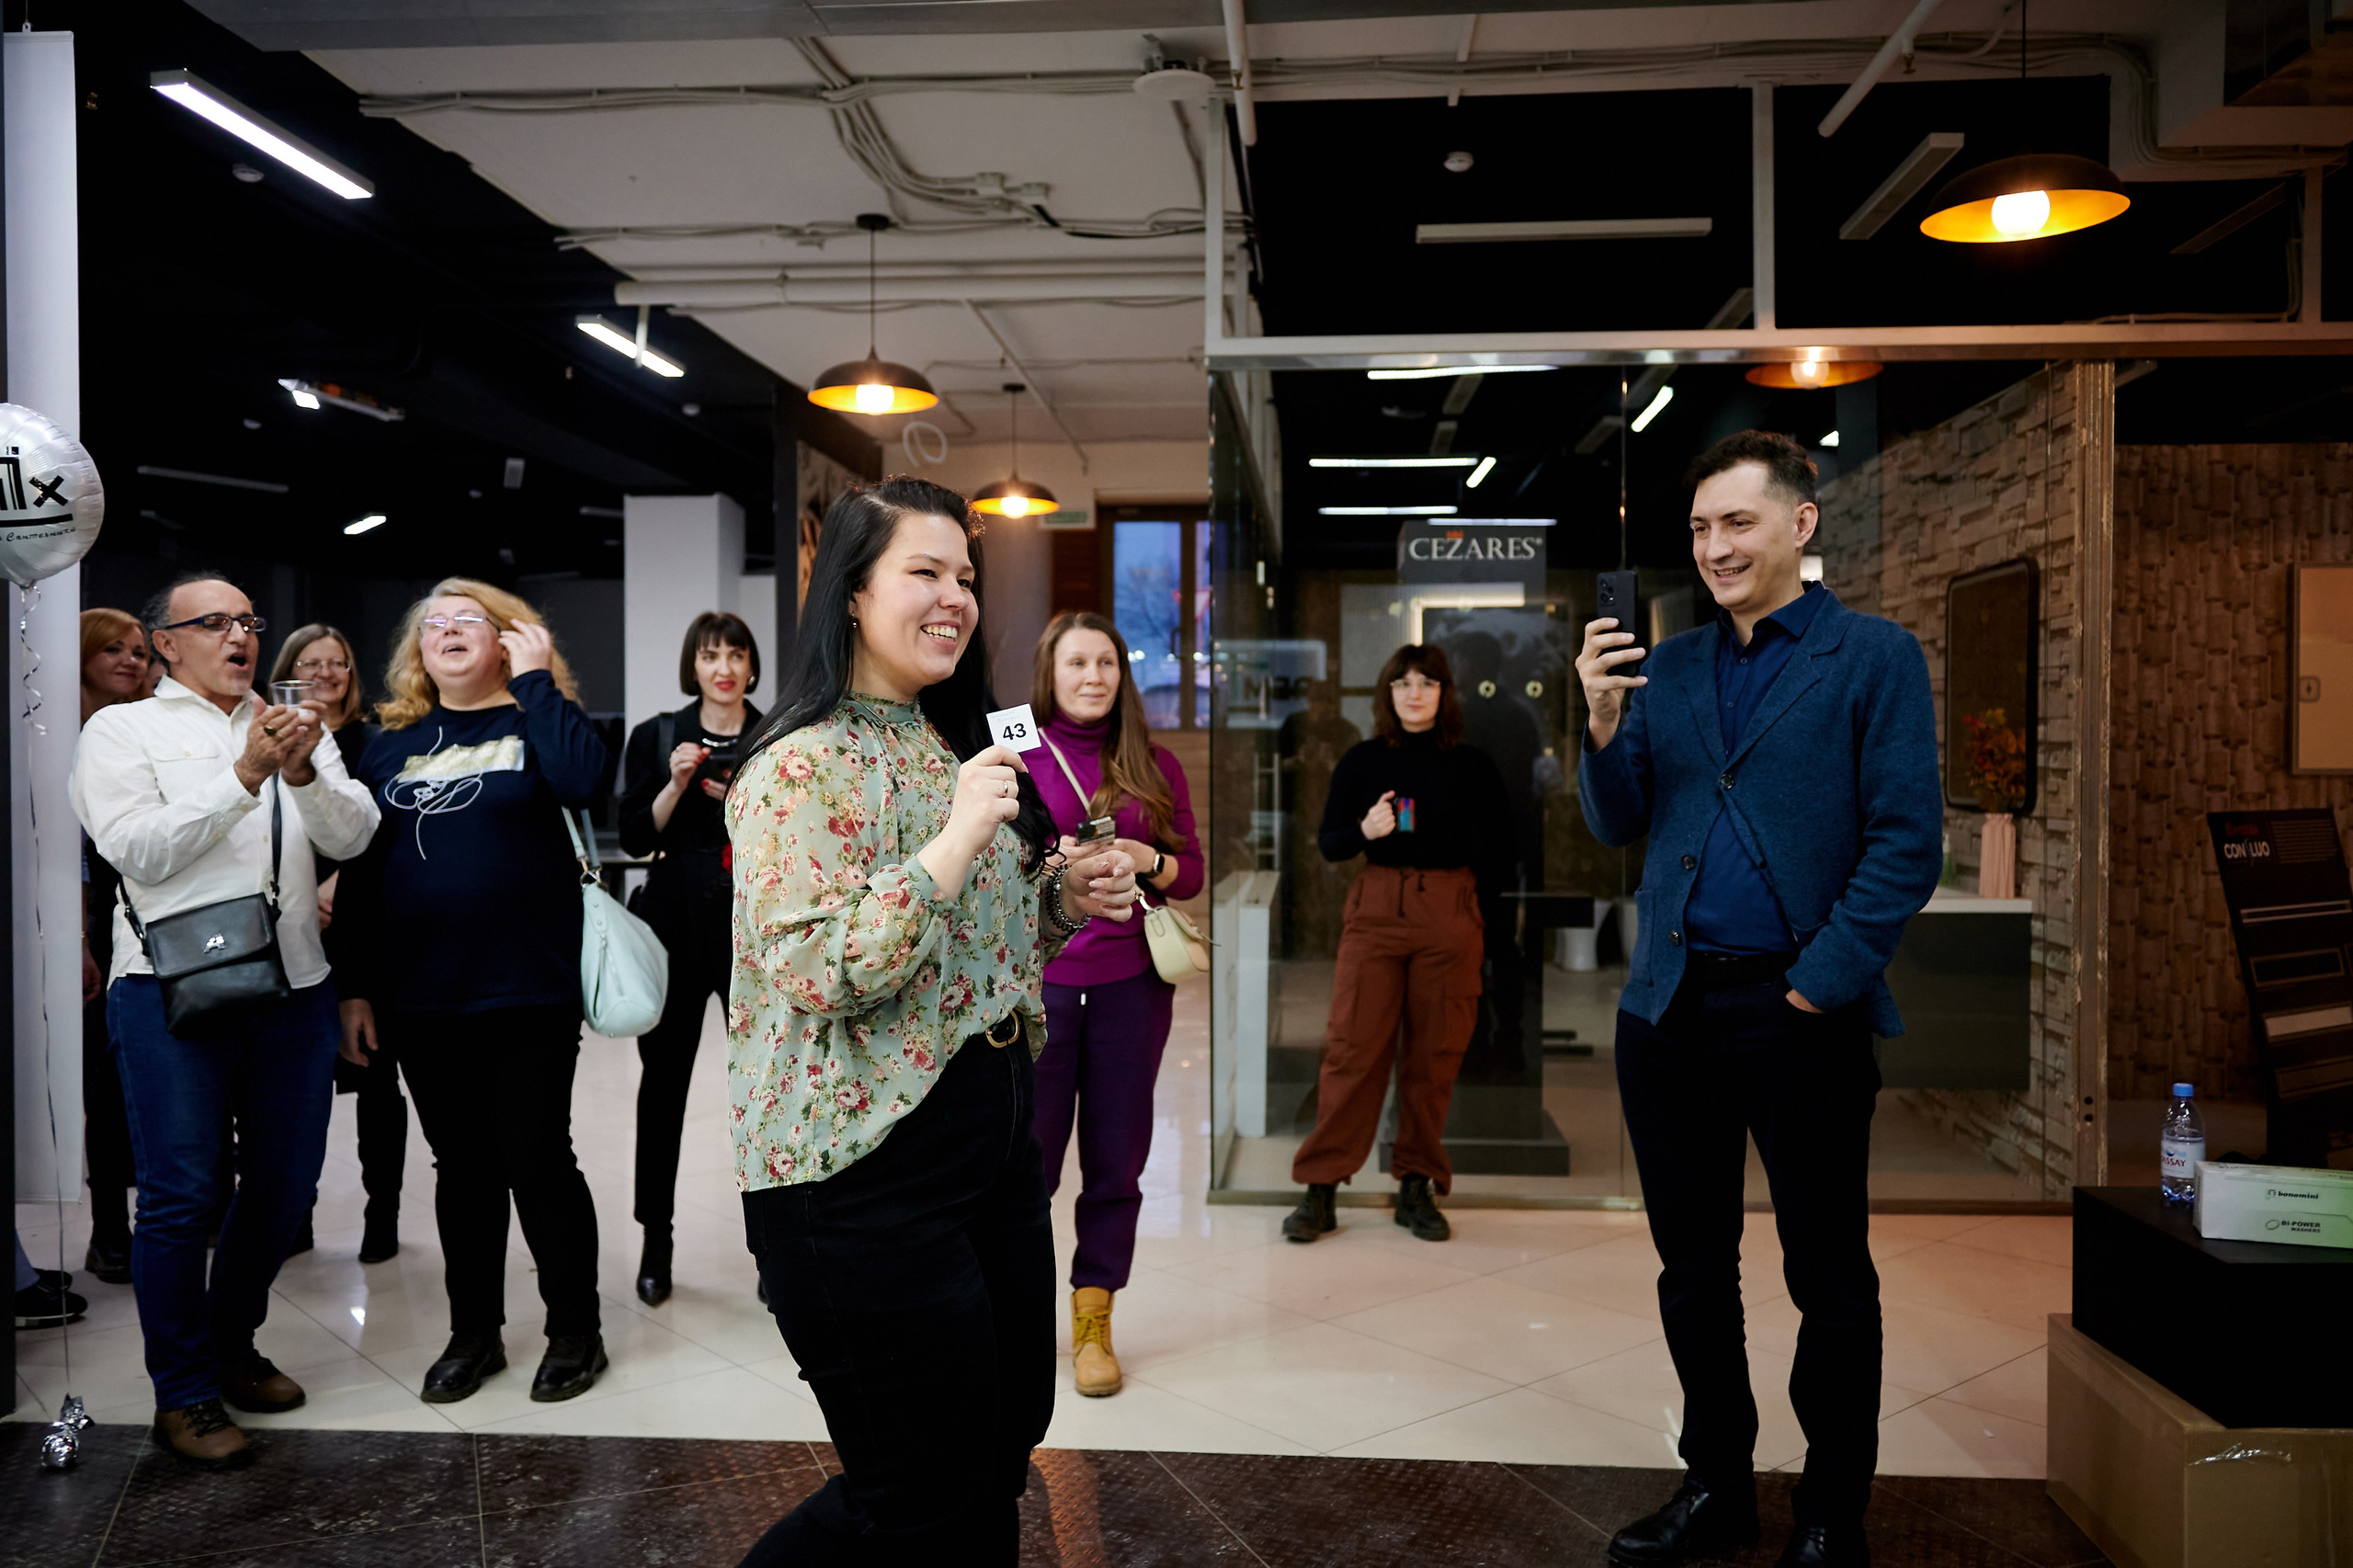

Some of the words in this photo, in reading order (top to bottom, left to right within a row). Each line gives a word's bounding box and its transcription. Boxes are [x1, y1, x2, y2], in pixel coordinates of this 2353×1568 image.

[1003, 723, 1027, 740] 43
[2162, 1156, 2186, 1166] ASSAY
[2278, 1191, 2319, 1199] bonomini
